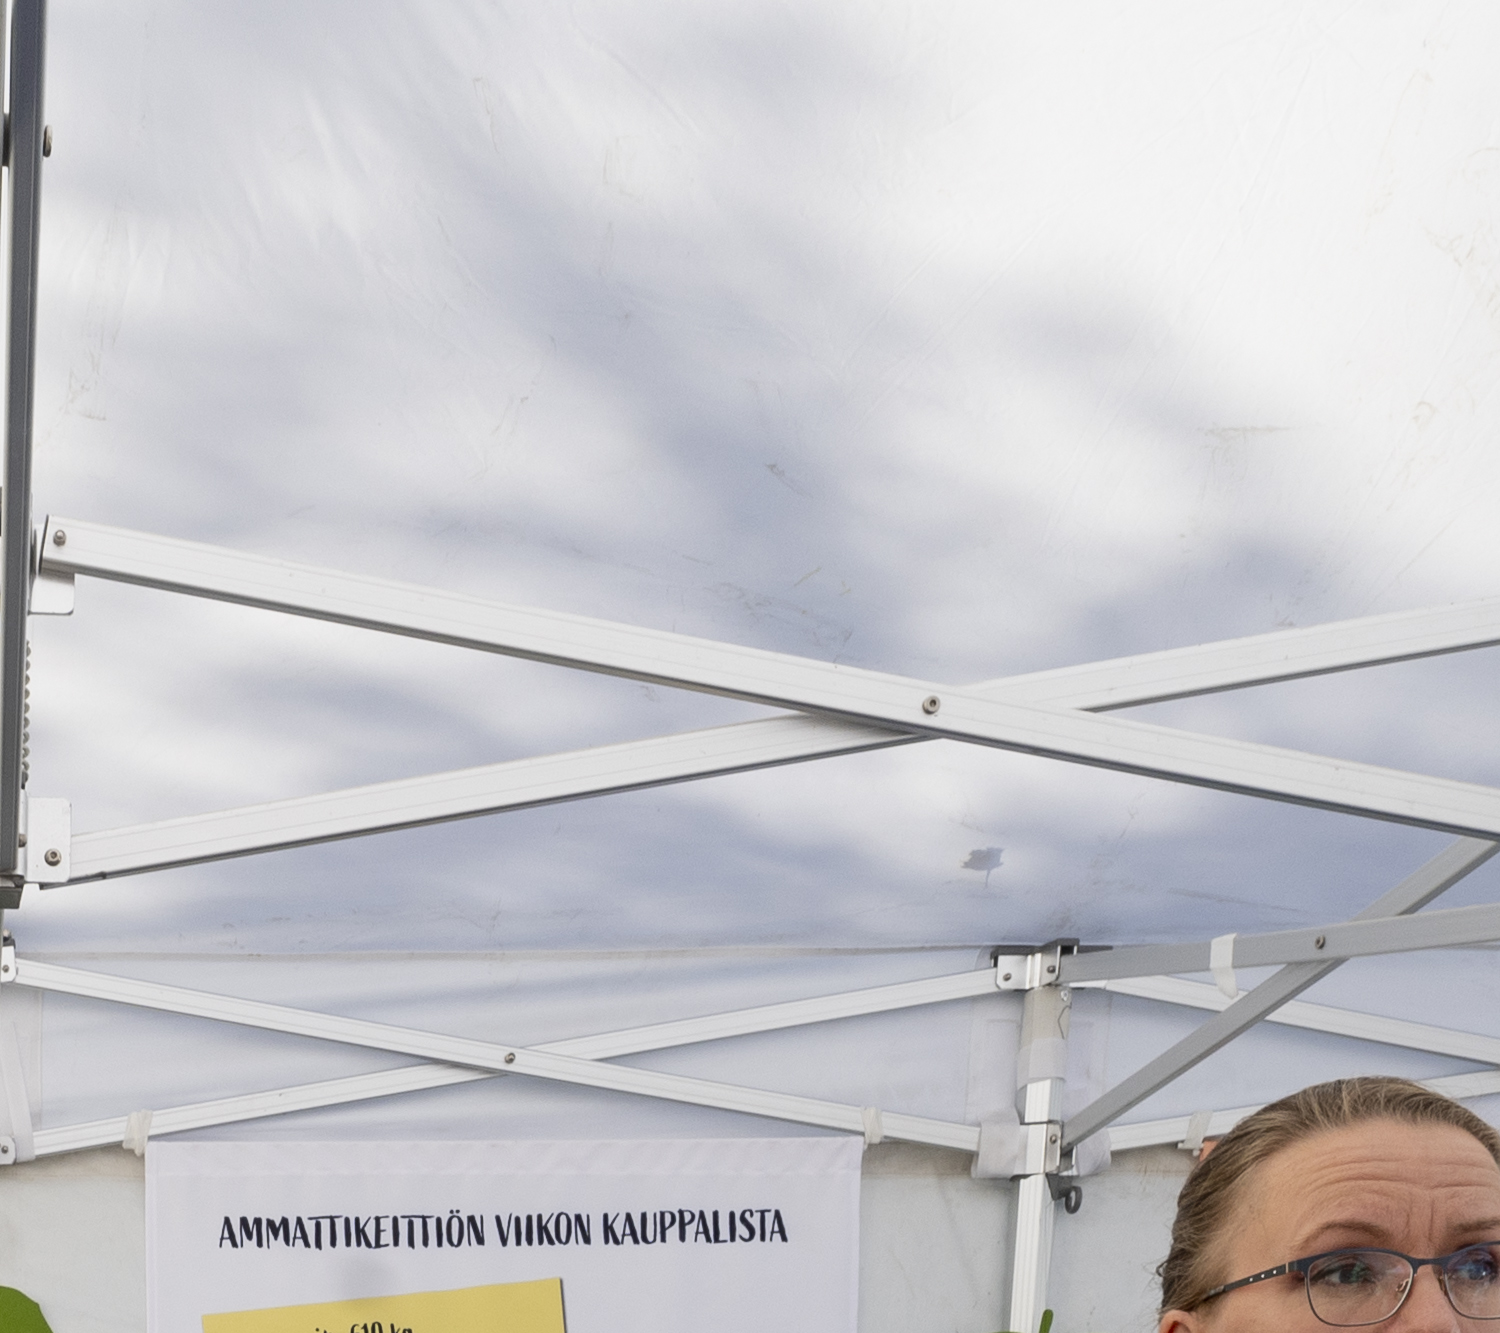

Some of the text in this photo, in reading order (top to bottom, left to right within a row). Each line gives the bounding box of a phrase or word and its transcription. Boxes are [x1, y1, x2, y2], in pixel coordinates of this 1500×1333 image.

[218, 1208, 789, 1251] AMMATTIKEITTIÖN VIIKON KAUPPALISTA
